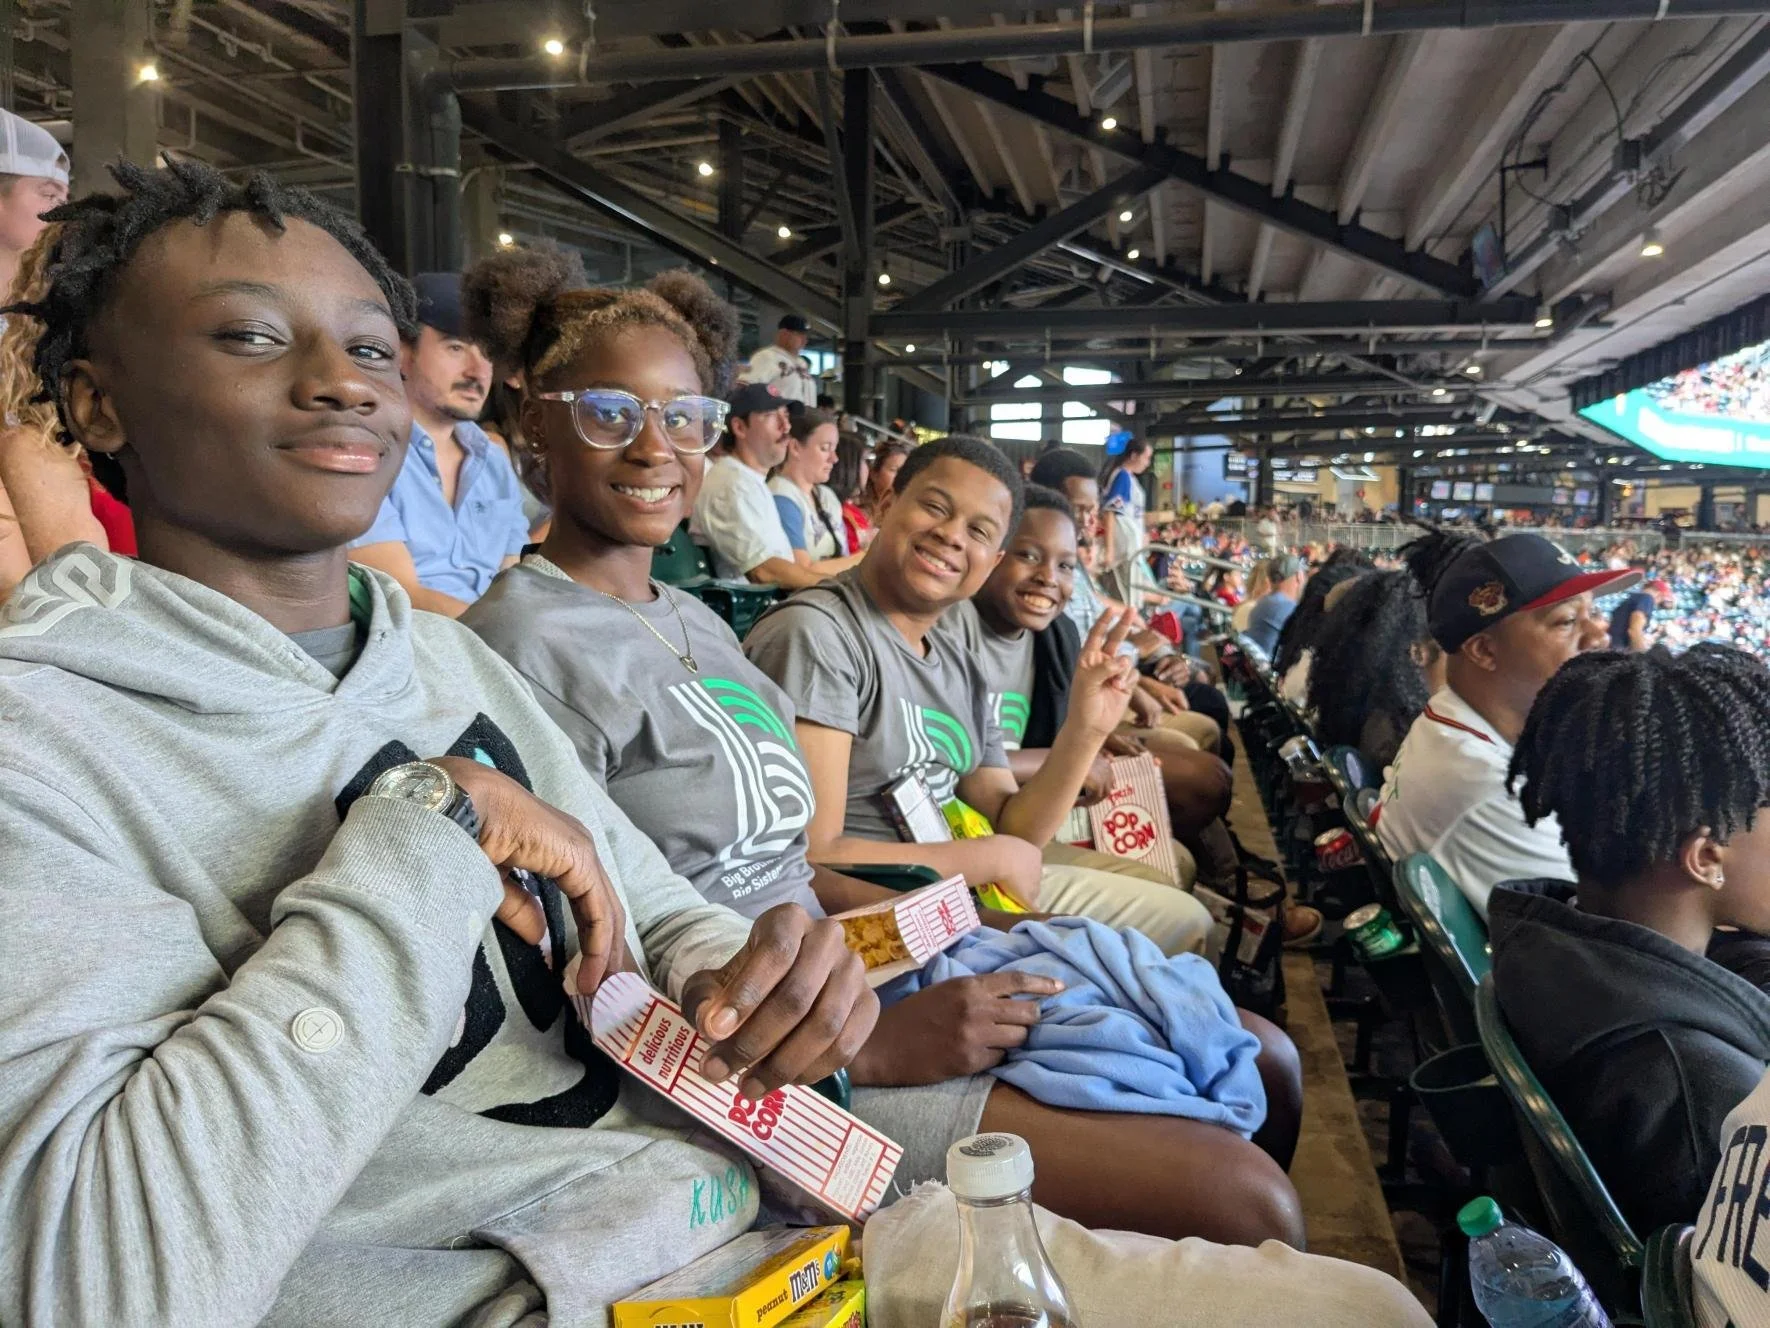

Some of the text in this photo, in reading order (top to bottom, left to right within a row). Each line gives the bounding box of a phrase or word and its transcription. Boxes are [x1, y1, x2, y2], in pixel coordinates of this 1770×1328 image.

[1103, 811, 1139, 838] POP
[1114, 822, 1155, 854] CORN
[721, 873, 746, 888] Big
[639, 1018, 672, 1065] delicious
[658, 1025, 690, 1080] nutritious
[728, 1092, 757, 1129] PO
[756, 1288, 788, 1323] peanut
